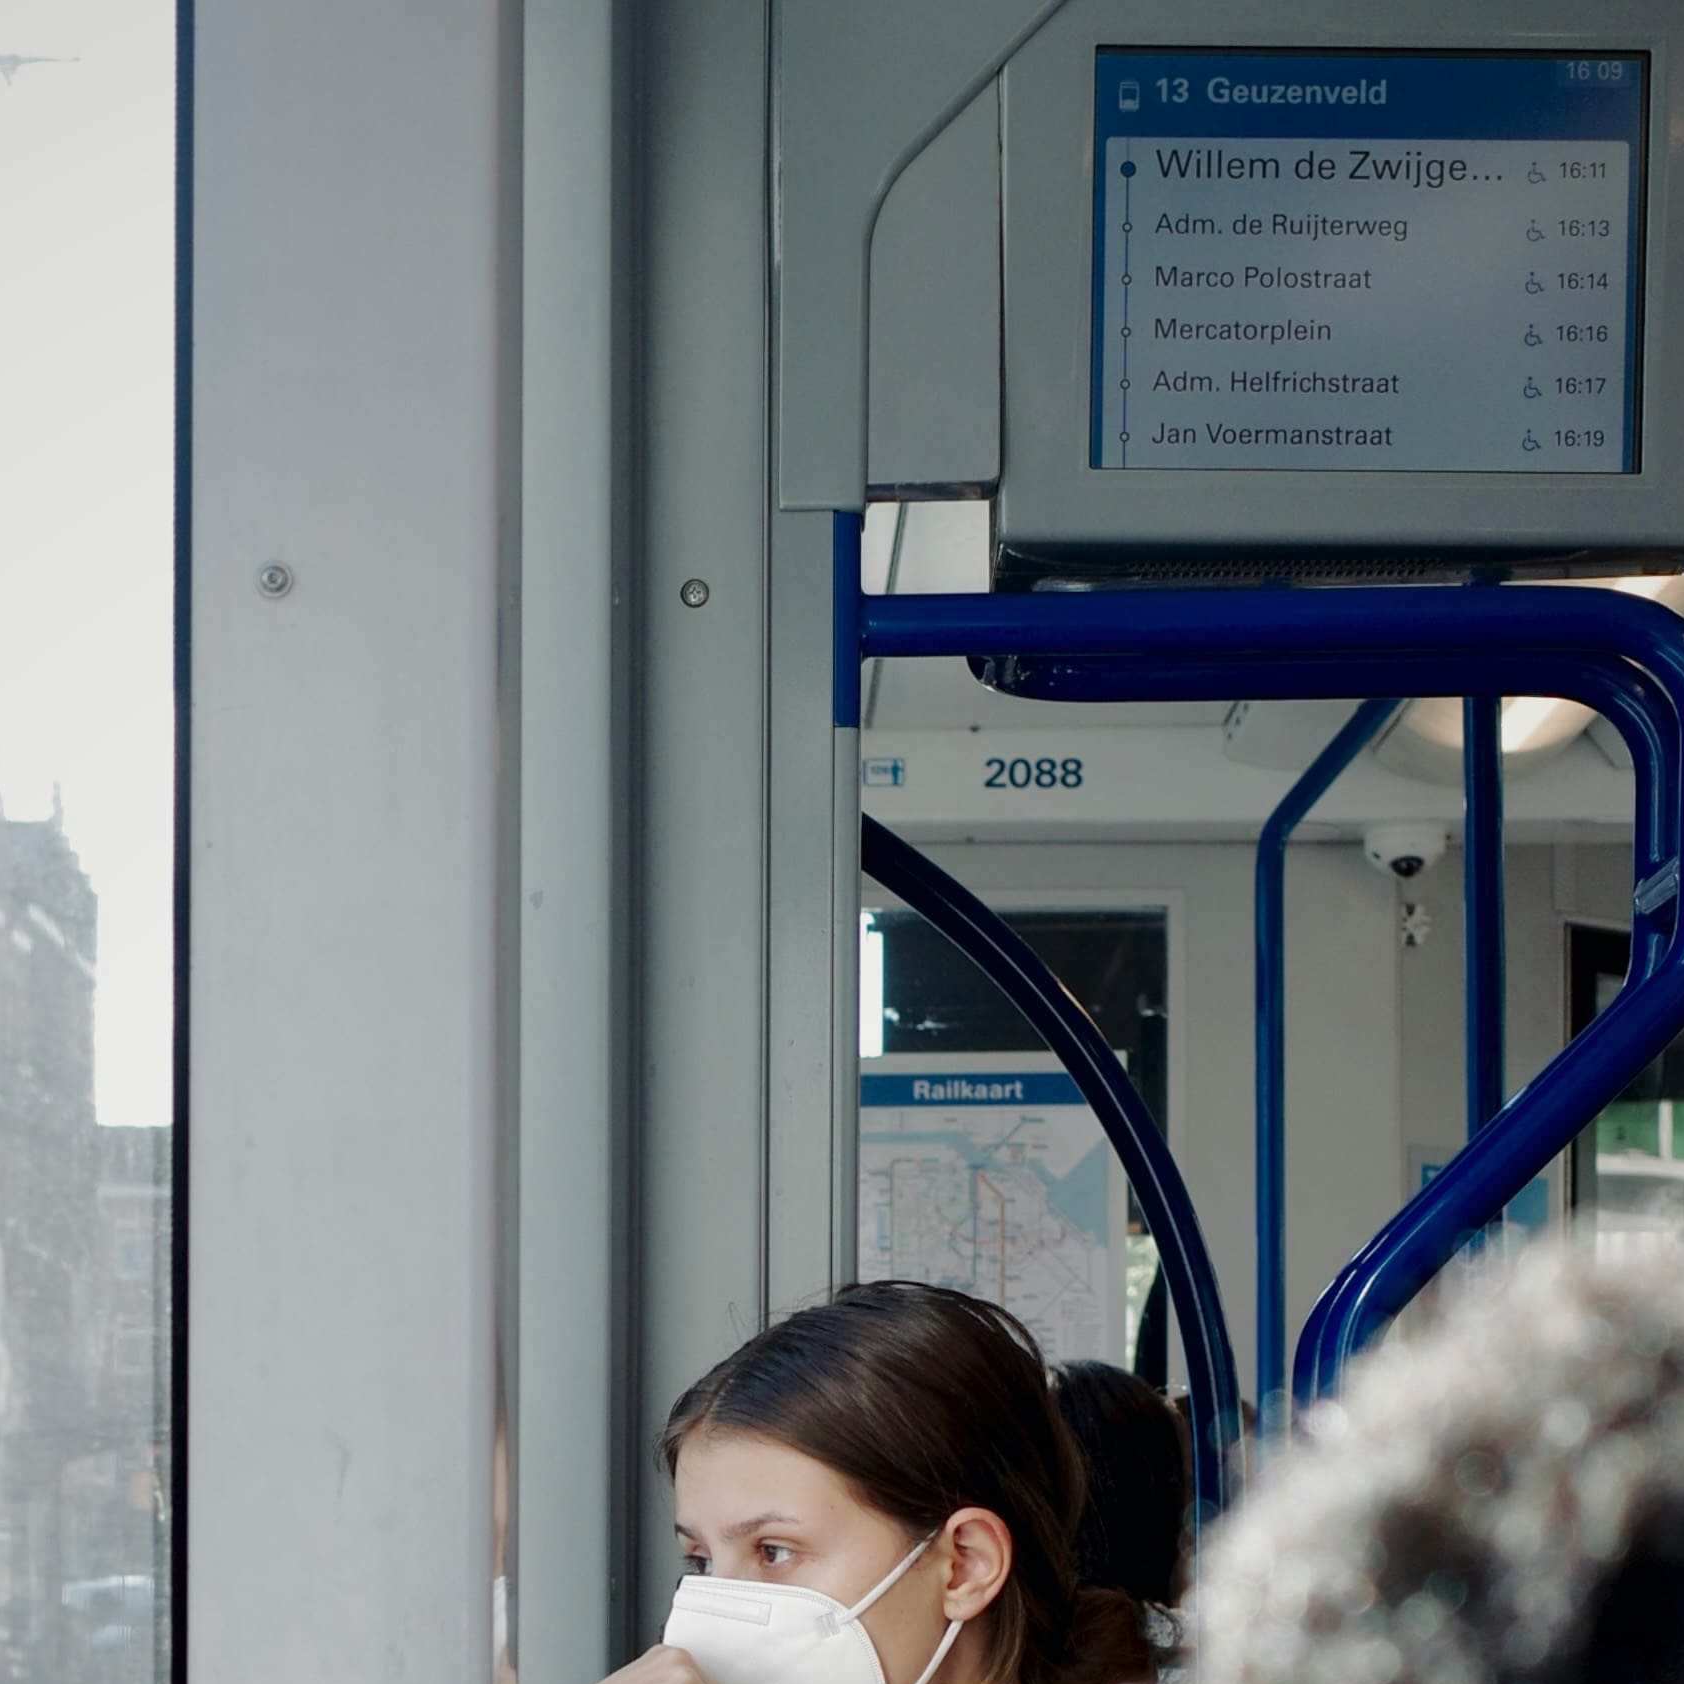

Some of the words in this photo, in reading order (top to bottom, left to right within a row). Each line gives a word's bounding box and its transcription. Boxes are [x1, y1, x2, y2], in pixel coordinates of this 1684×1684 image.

[1155, 77, 1191, 104] 13
[1207, 77, 1388, 105] Geuzenveld
[1155, 149, 1281, 181] Willem
[1294, 150, 1337, 181] de
[1348, 150, 1504, 189] Zwijge...
[1559, 161, 1607, 181] 16:11
[1154, 214, 1223, 236] Adm.
[1232, 214, 1263, 236] de
[1271, 214, 1409, 242] Ruijterweg
[1557, 219, 1610, 238] 16:13
[1154, 266, 1235, 289] Marco
[1243, 266, 1373, 290] Polostraat
[1557, 272, 1609, 291] 16:14
[1153, 318, 1333, 346] Mercatorplein
[1555, 325, 1608, 343] 16:16
[1152, 371, 1221, 394] Adm.
[1229, 371, 1400, 395] Helfrichstraat
[1554, 377, 1606, 396] 16:17
[1151, 424, 1197, 446] Jan
[1205, 424, 1393, 448] Voermanstraat
[1553, 429, 1605, 448] 16:19
[983, 757, 1084, 789] 2088
[913, 1079, 1024, 1101] Railkaart
